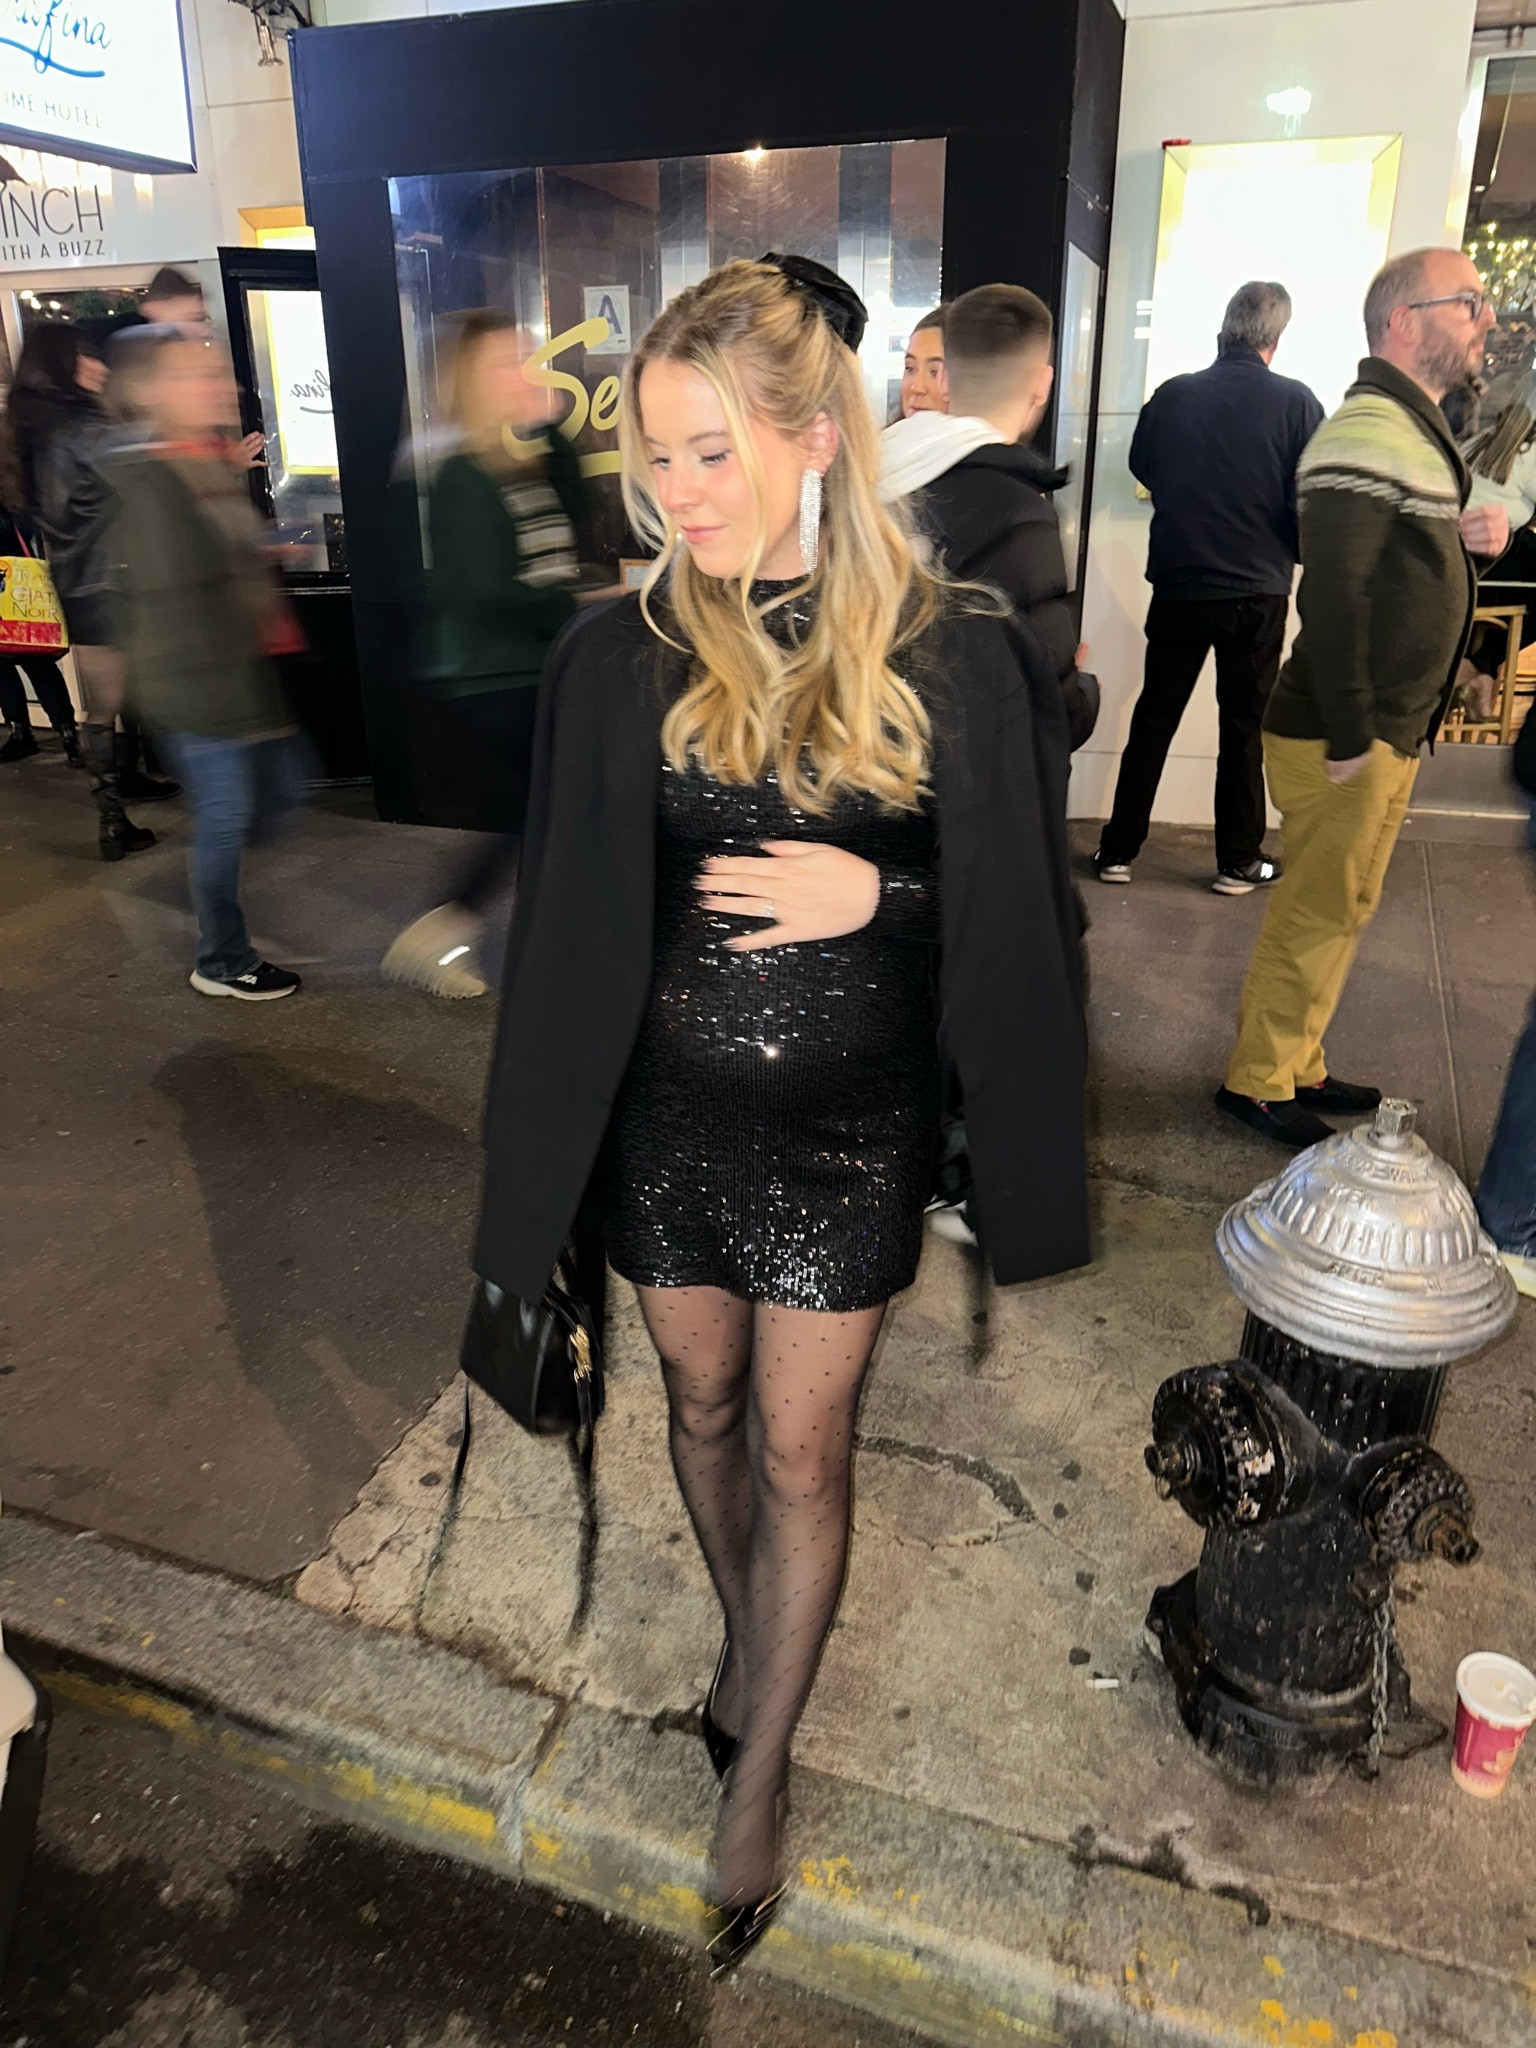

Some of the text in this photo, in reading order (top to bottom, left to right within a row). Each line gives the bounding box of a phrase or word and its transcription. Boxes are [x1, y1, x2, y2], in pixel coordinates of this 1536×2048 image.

[44, 100, 102, 129] HOTEL
[40, 242, 51, 259] A
[58, 239, 105, 258] BUZZ
[598, 294, 622, 334] A
